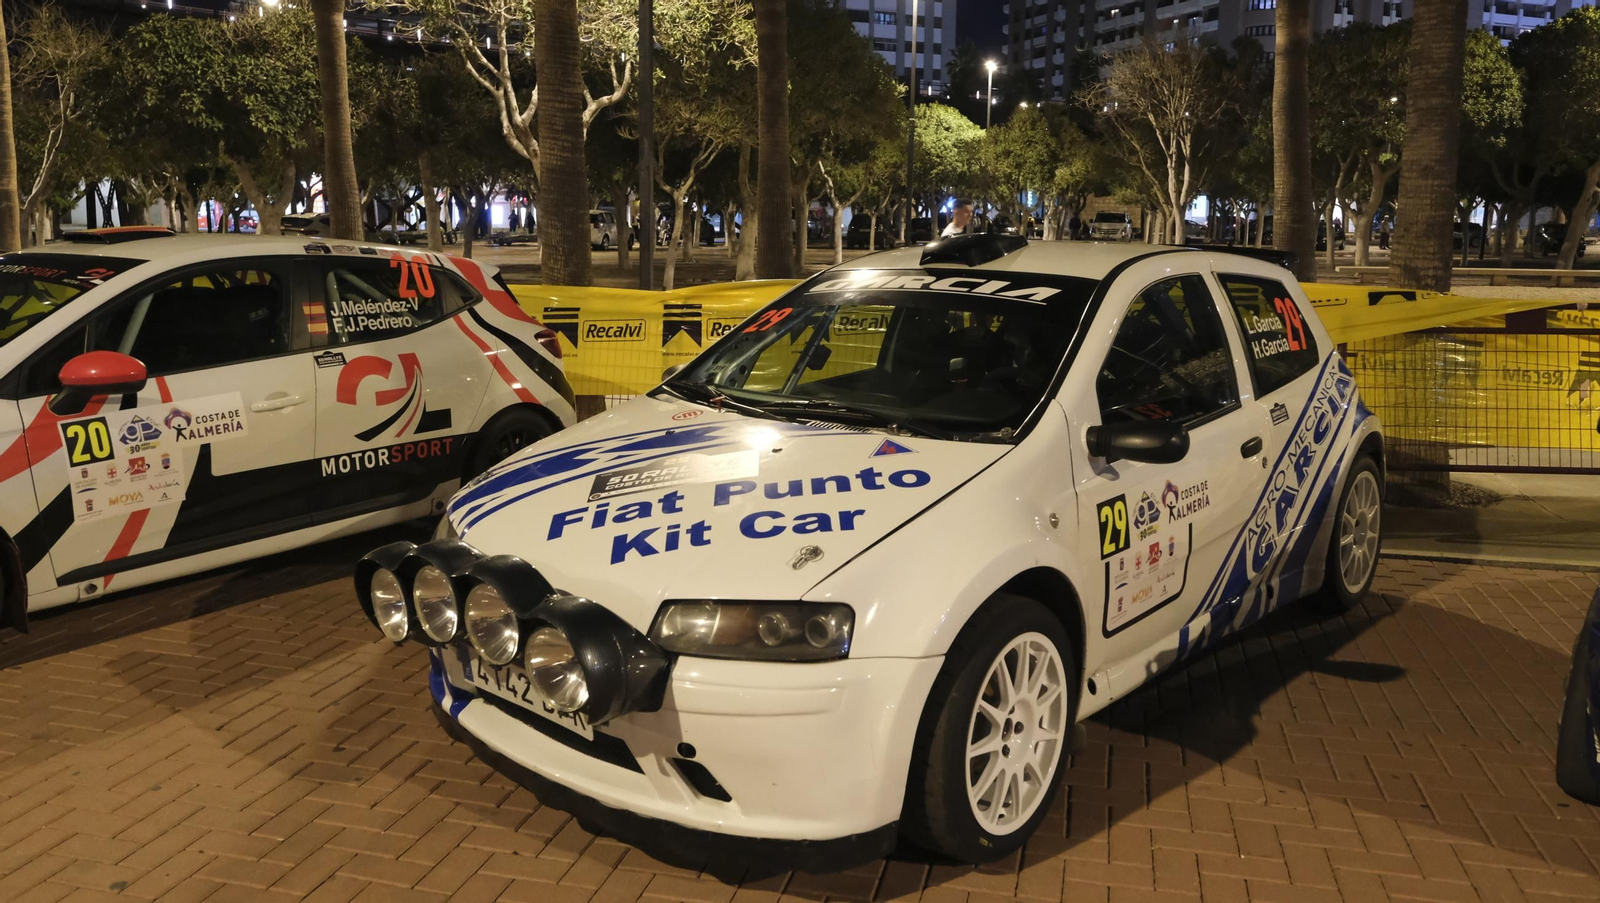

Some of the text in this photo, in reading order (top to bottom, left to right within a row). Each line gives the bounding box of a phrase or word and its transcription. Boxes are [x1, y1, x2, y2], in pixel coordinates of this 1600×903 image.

[390, 254, 435, 298] 20
[809, 276, 1062, 301] GARCIA
[330, 297, 419, 317] J.Meléndez-V
[742, 307, 793, 333] 29
[332, 315, 413, 334] F.J.Pedrero
[586, 322, 643, 339] Recalvi
[1274, 297, 1307, 351] 29
[188, 419, 244, 440] ALMERÍA
[195, 409, 241, 425] COSTA DE
[66, 421, 111, 463] 20
[130, 444, 141, 454] 30
[321, 438, 453, 477] MOTORSPORT
[605, 478, 651, 490] COSTA
[653, 475, 674, 483] DE
[607, 458, 744, 485] 50 RALYE
[1252, 375, 1351, 574] GARCIA
[109, 491, 143, 506] MOYA
[1181, 480, 1208, 500] COSTA DE
[547, 467, 931, 541] Fiat Punto
[1176, 493, 1210, 521] ALMERÍA
[611, 509, 866, 565] Kit Car
[1100, 500, 1127, 555] 29
